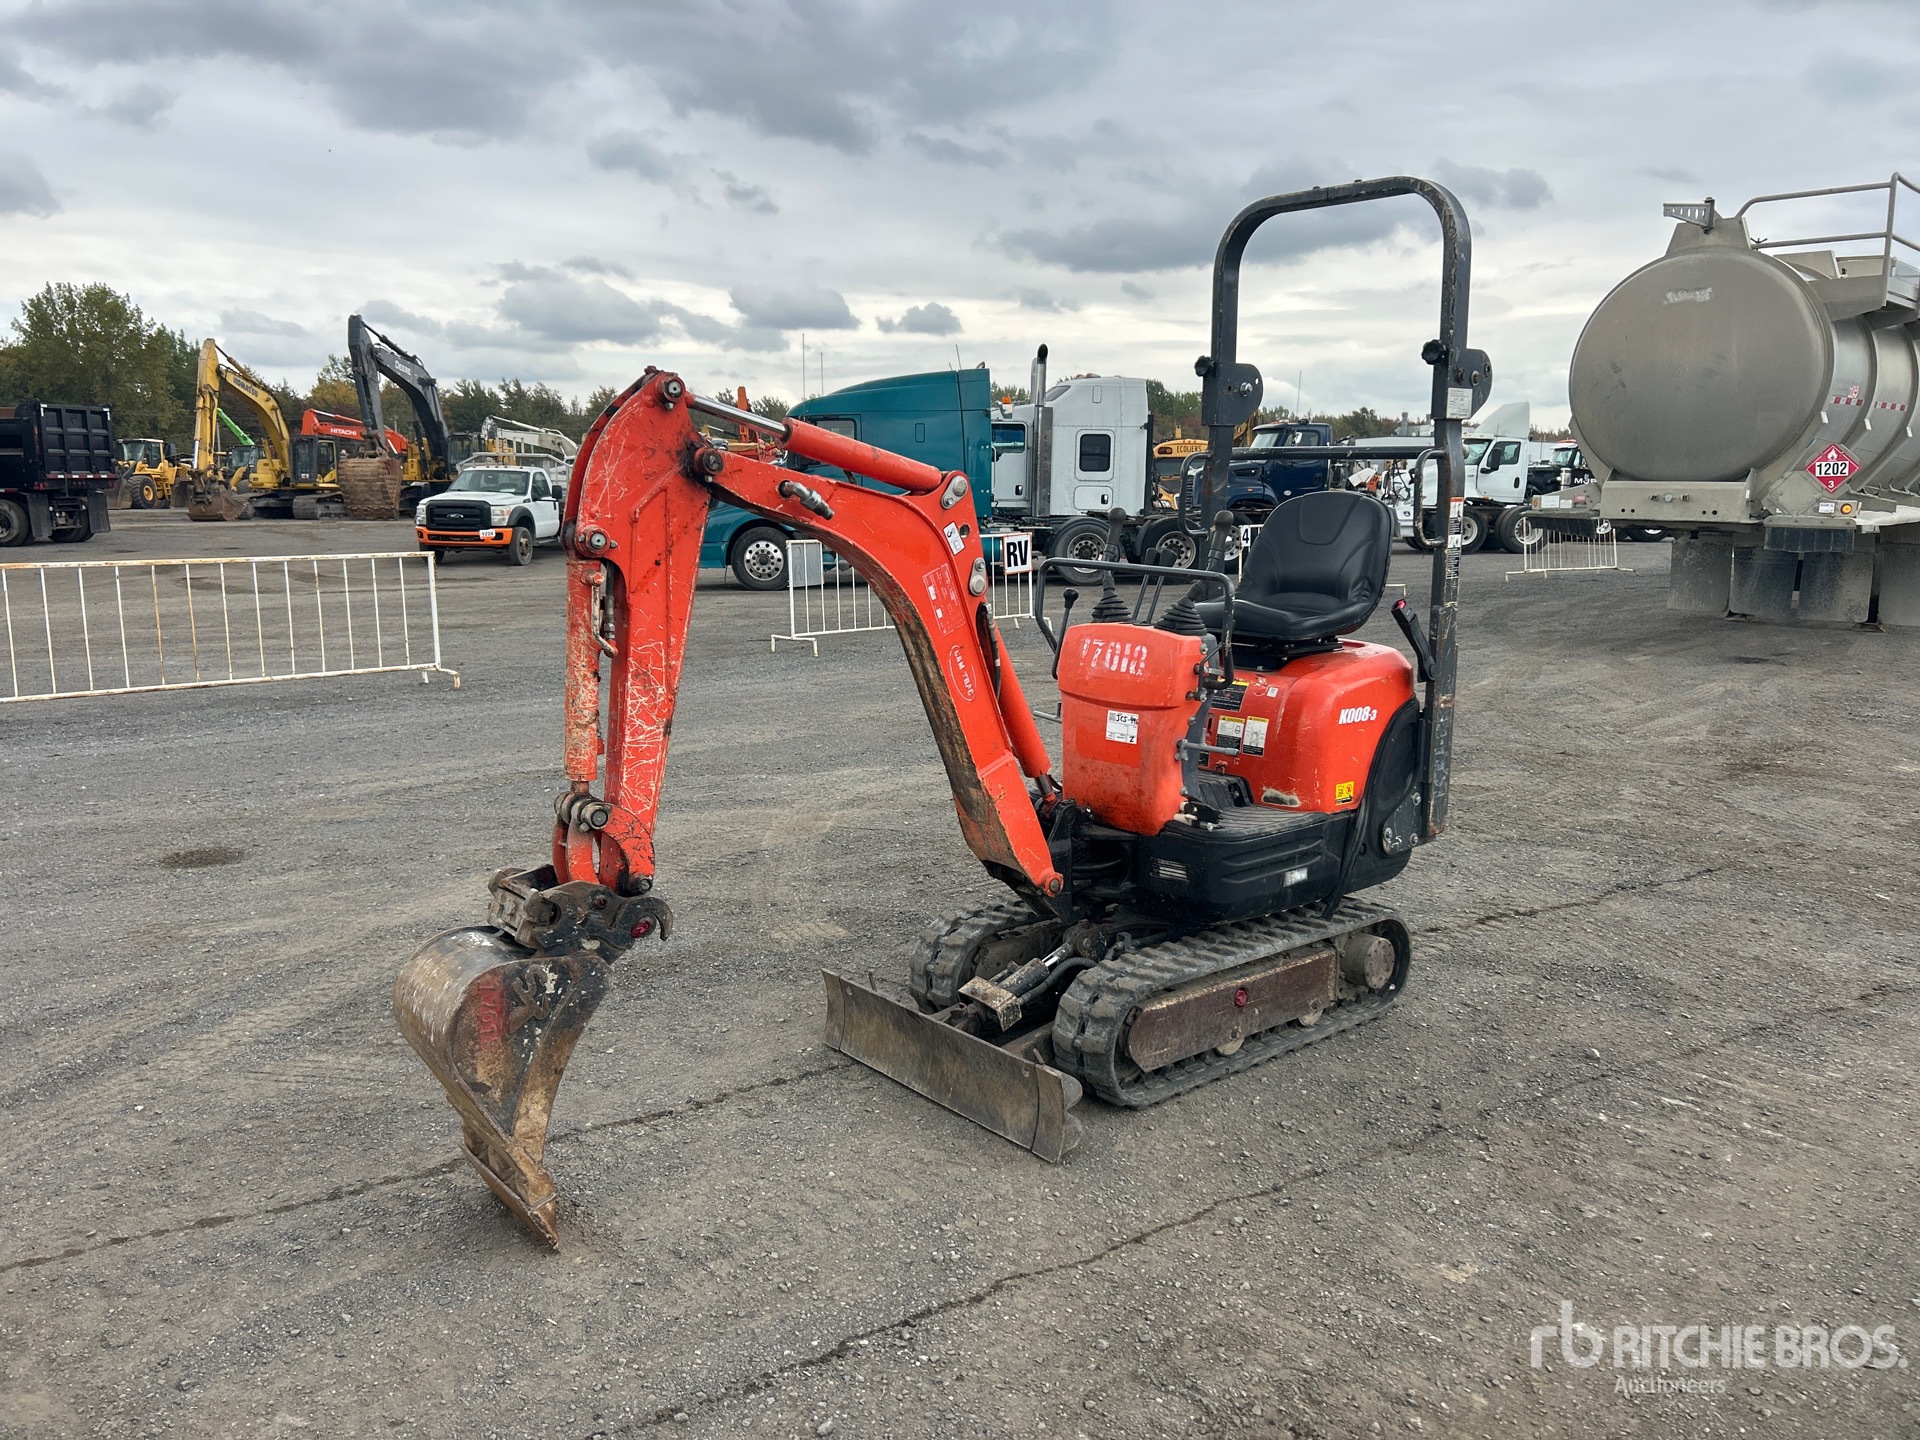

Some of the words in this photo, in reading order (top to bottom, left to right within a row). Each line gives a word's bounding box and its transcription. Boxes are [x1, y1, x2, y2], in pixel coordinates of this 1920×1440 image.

[330, 427, 357, 436] HITACHI
[1816, 462, 1848, 476] 1202
[1827, 480, 1835, 488] 3
[1242, 528, 1250, 544] 4
[1006, 540, 1029, 568] RV
[1338, 706, 1378, 725] K008-3
